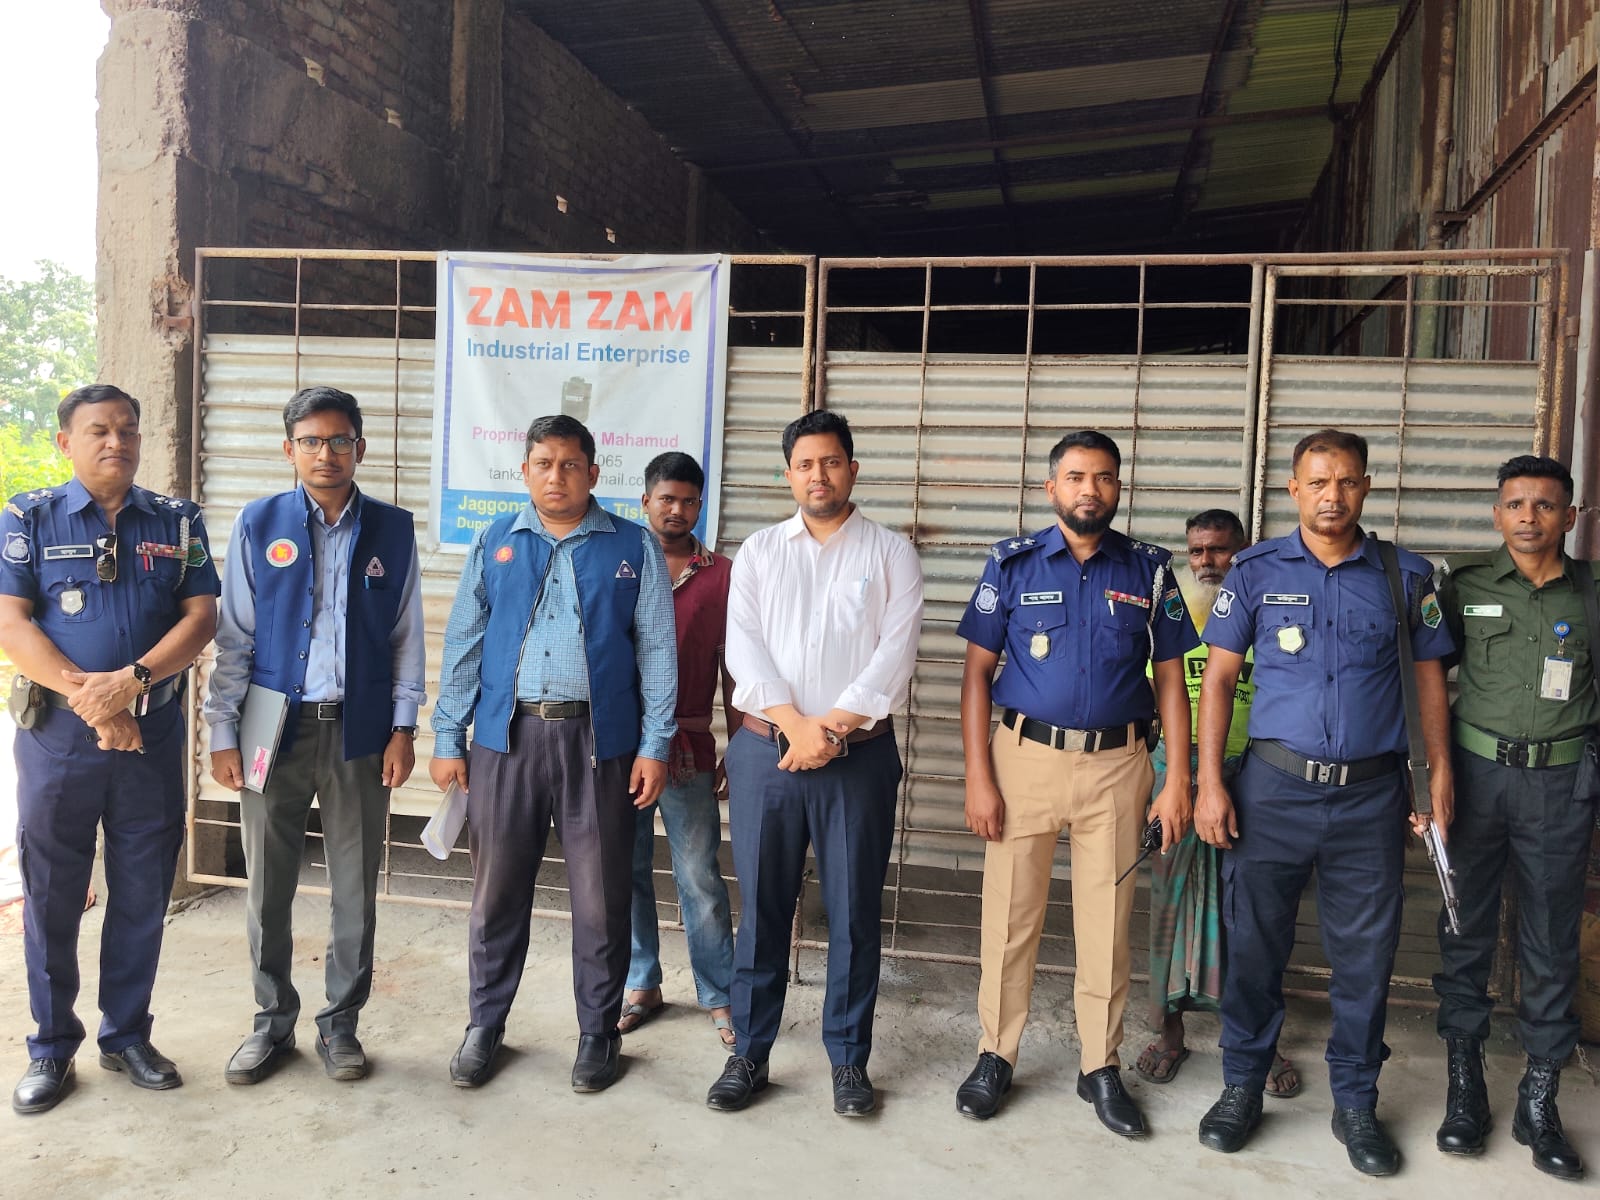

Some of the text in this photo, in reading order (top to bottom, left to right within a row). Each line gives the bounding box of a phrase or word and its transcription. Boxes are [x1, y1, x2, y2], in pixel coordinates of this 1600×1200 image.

[466, 286, 694, 333] ZAM ZAM
[467, 338, 691, 368] Industrial Enterprise
[471, 426, 528, 445] Proprie
[601, 431, 679, 449] Mahamud
[597, 454, 624, 469] 065
[458, 494, 528, 516] Jaggona
